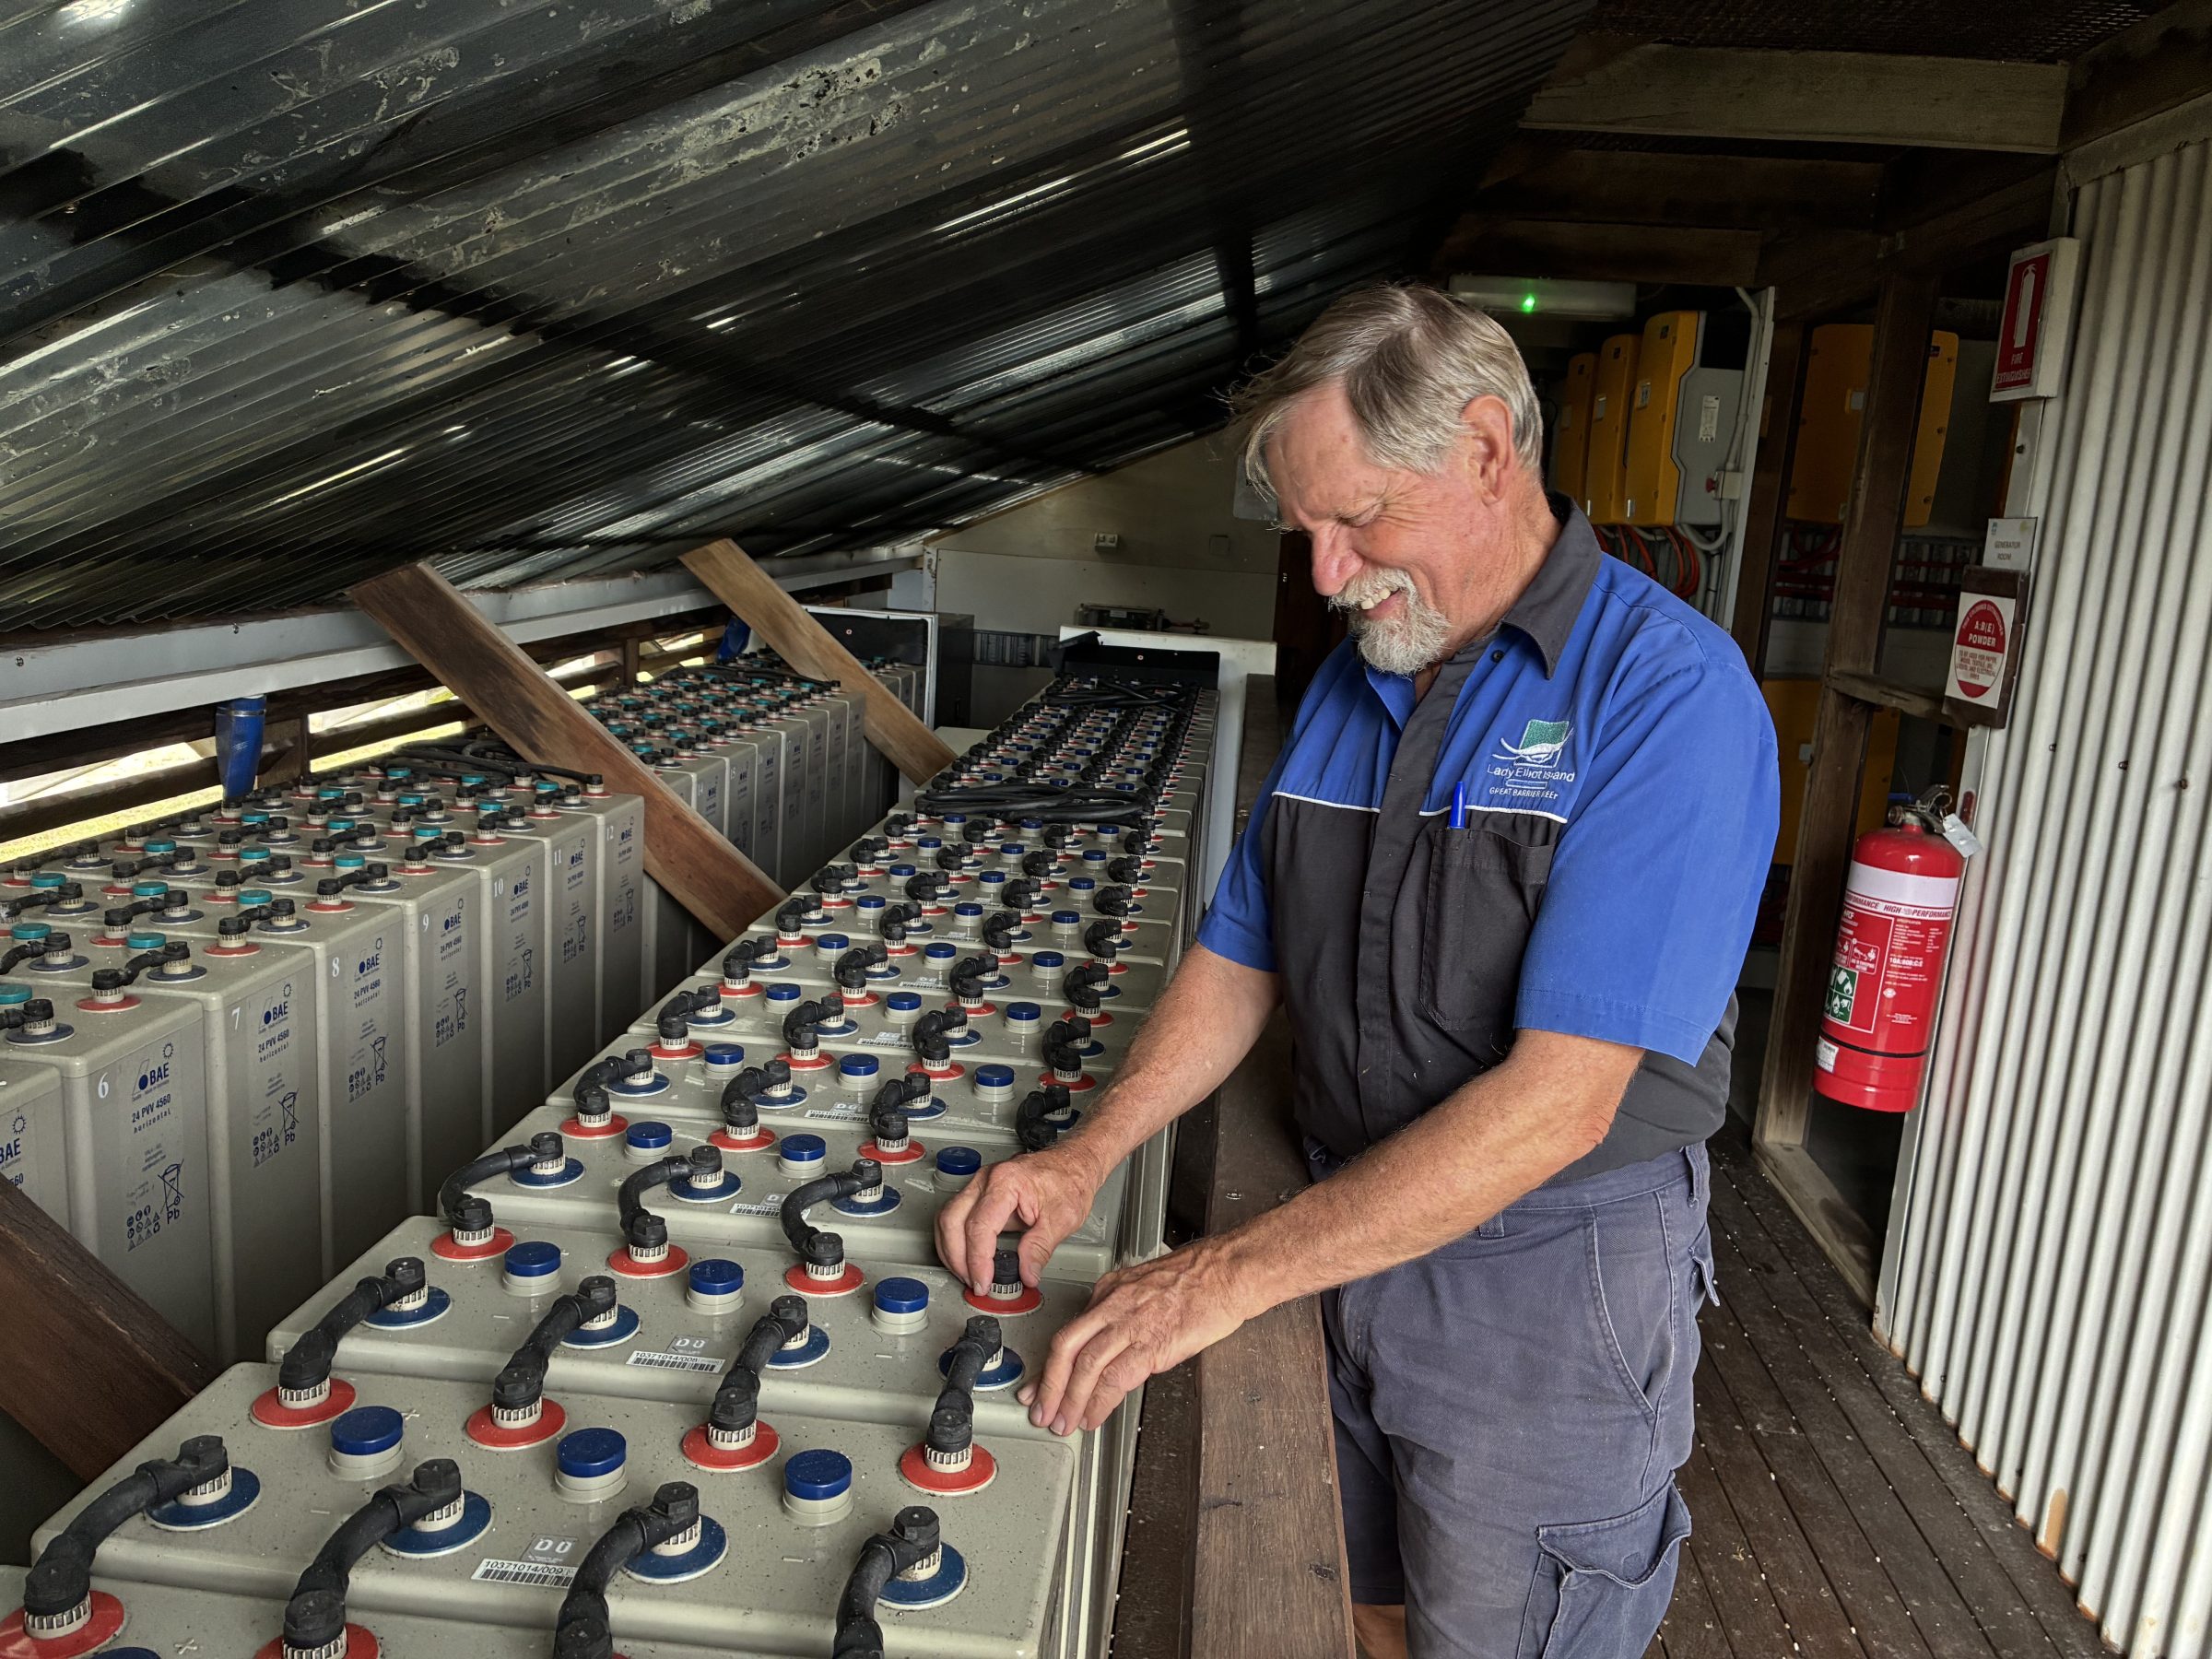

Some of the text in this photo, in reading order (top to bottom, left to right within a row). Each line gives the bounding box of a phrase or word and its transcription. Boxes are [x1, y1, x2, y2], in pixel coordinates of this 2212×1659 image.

[1994, 541, 2020, 549] GENERATOR
[1997, 553, 2012, 561] ROOM
[1968, 633, 1996, 647] POWDER
[1487, 764, 1575, 782] Lady Elliot Island
[1489, 787, 1512, 795] GREAT
[1512, 788, 1542, 797] BARRIER
[606, 826, 615, 841] 12
[554, 849, 562, 865] 11
[575, 850, 583, 865] BAE
[494, 878, 504, 898] 10
[518, 878, 529, 894] BAE
[1883, 904, 1902, 913] HIGH
[422, 913, 429, 932] 9
[450, 913, 462, 928] BAE
[332, 957, 340, 978] 8
[366, 953, 380, 971] BAE
[354, 979, 381, 999] 24 PVV 4560
[355, 991, 380, 1008] horizontal
[232, 1006, 241, 1030] 7
[273, 1001, 288, 1021] BAE
[258, 1029, 289, 1053] 24 PVV 4560
[260, 1042, 288, 1063] horizontal
[150, 1062, 170, 1086] BAE
[375, 1073, 384, 1085] Pb
[98, 1072, 109, 1098] 6
[132, 1094, 171, 1123] 24 PVV 4560
[134, 1109, 171, 1134] horizontal
[284, 1132, 295, 1146] Pb
[0, 1138, 21, 1163] BAE
[9, 1172, 24, 1186] 560
[167, 1208, 180, 1224] Pb
[485, 1560, 563, 1575] 10371014/009
